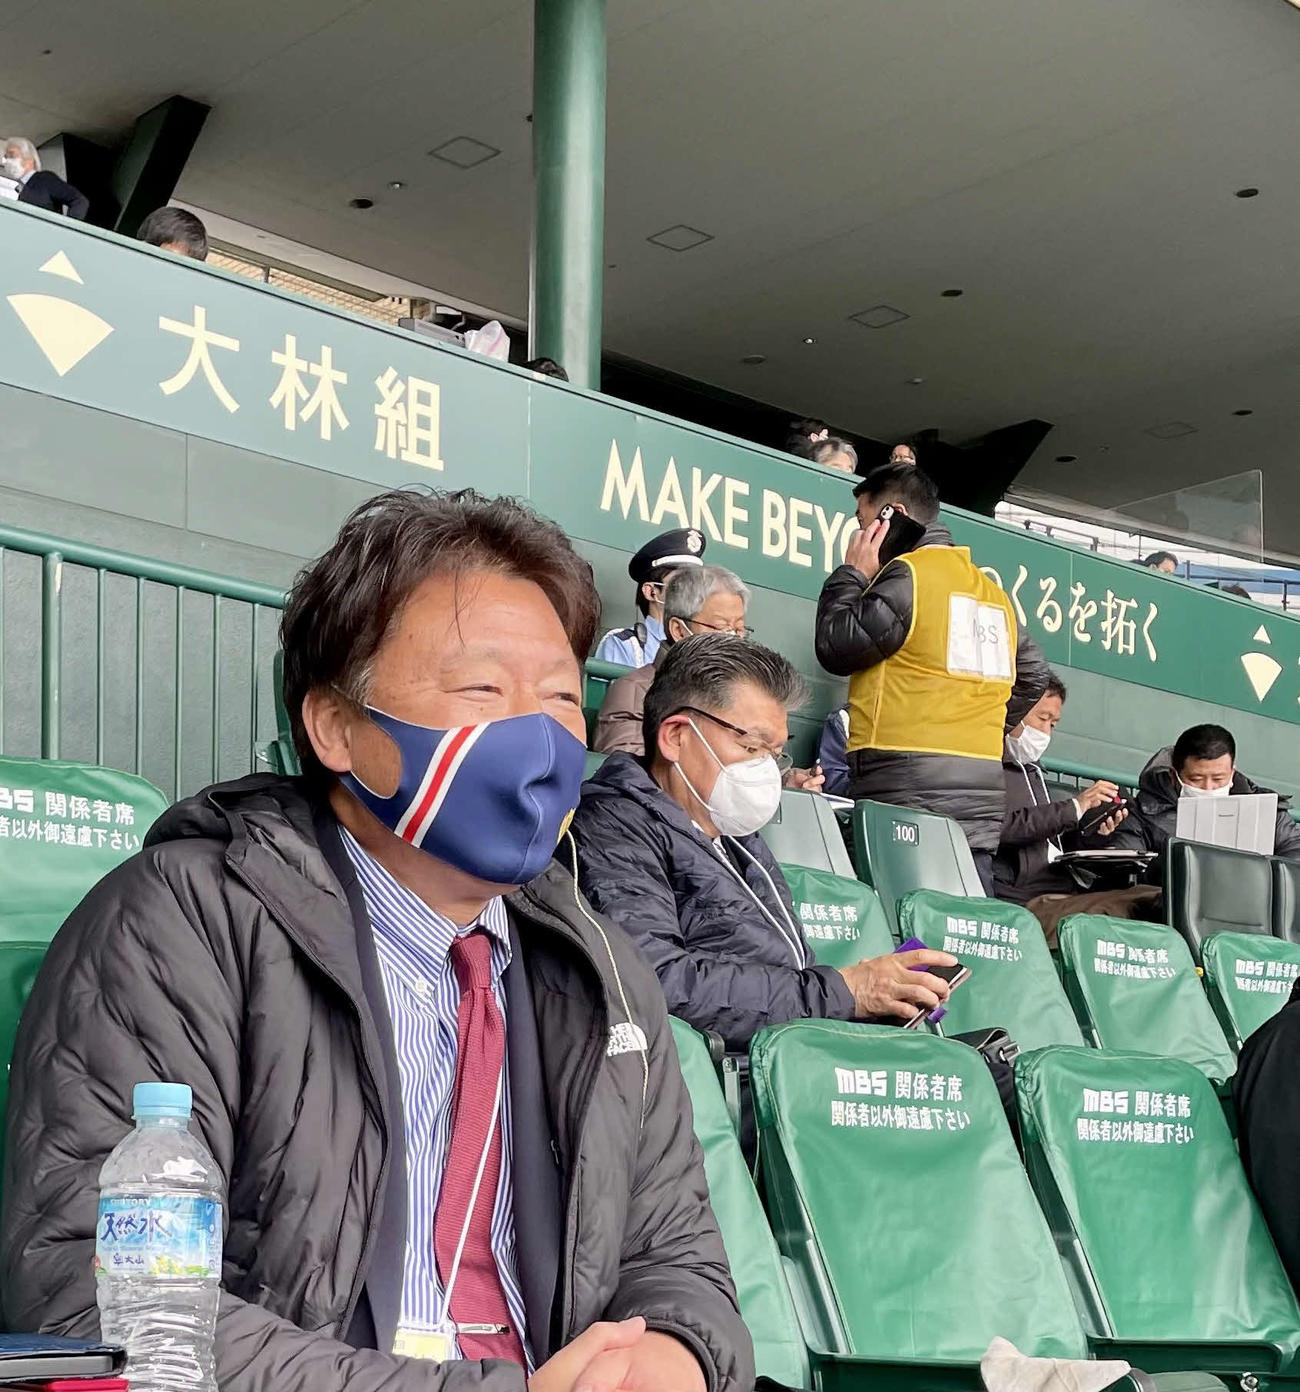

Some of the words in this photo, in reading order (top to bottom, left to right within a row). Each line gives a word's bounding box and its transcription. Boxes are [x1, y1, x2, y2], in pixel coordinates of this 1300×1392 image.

[158, 304, 444, 472] 大林組
[600, 438, 750, 550] MAKE
[45, 791, 135, 826] 関係者席
[895, 825, 915, 843] 100
[800, 902, 858, 922] 関係者席
[946, 916, 978, 937] MBS
[980, 921, 1019, 945] 関係者席
[942, 935, 1023, 962] 関係者以外御遠慮下さい
[1097, 939, 1126, 959] MBS
[1235, 959, 1265, 976] MBS
[834, 1066, 888, 1096] MBS
[894, 1070, 963, 1102] 関係者席
[830, 1100, 971, 1131] 関係者以外御遠慮下さい
[1083, 1088, 1129, 1114] MBS
[1134, 1090, 1191, 1118] 関係者席
[1077, 1117, 1194, 1144] 関係者以外御遠慮下さい
[100, 1211, 173, 1242] 天然水
